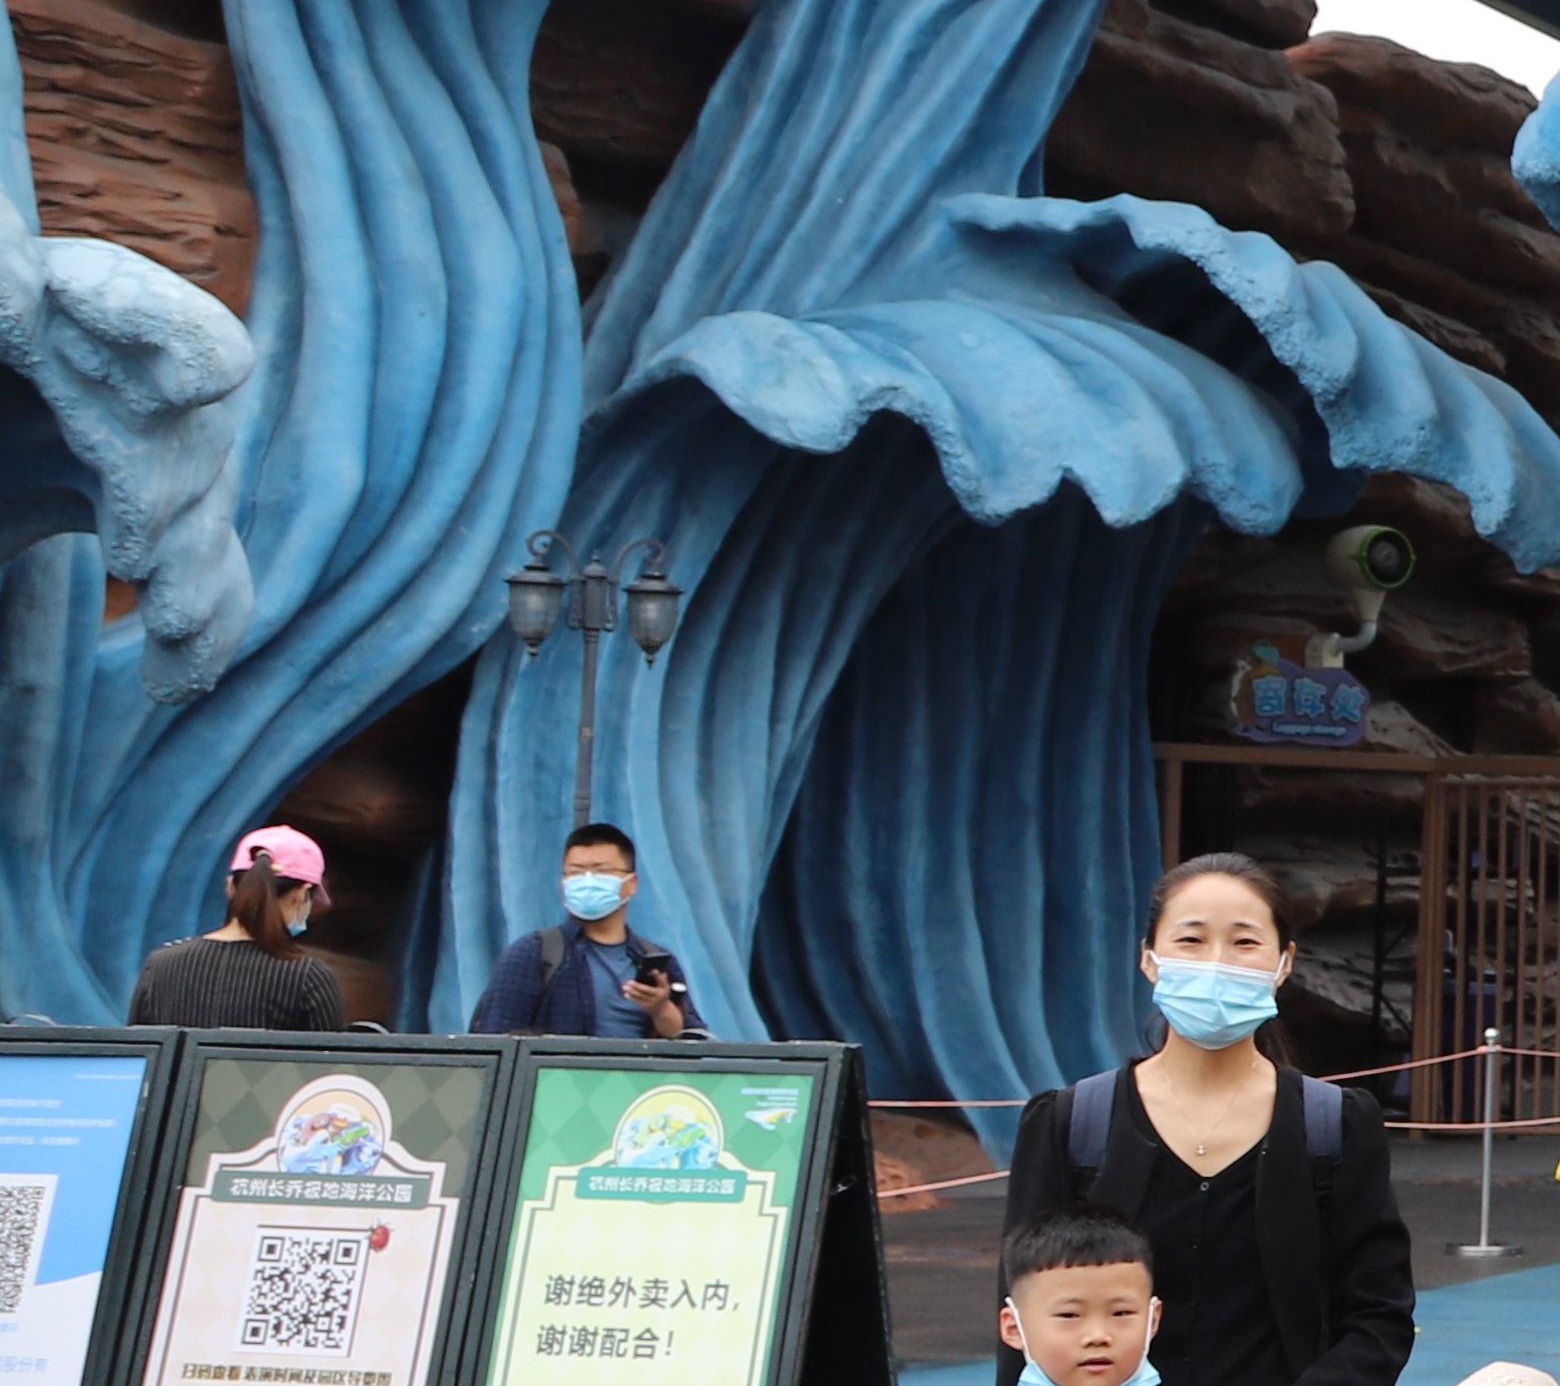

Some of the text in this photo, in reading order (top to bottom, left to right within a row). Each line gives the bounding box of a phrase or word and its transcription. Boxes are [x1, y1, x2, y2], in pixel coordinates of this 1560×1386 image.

[229, 1177, 414, 1203] 杭州长乔极地海洋公园
[588, 1175, 738, 1197] 杭州长乔极地海洋公园
